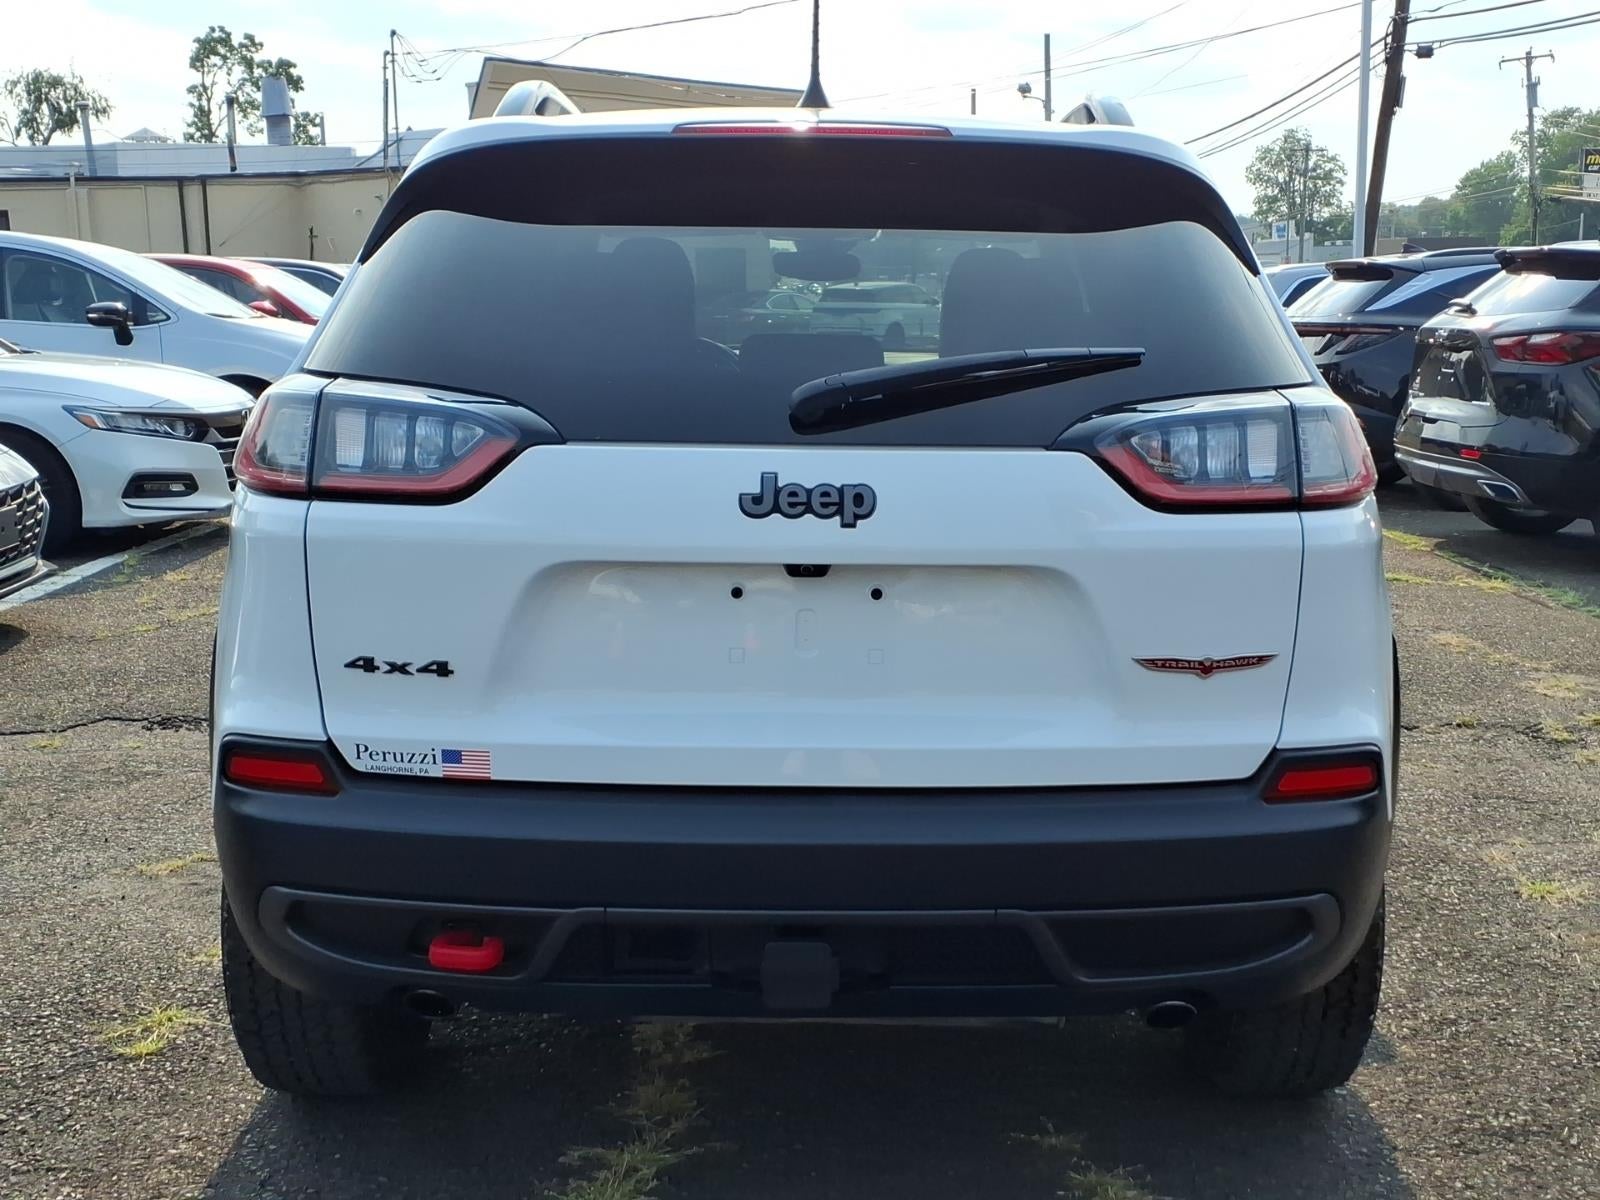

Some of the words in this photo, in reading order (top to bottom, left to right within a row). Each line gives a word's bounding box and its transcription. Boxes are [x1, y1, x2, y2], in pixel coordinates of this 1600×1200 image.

[738, 472, 877, 528] Jeep
[343, 655, 454, 677] 4x4
[354, 742, 439, 766] Peruzzi
[364, 763, 417, 775] LANGHORNE,
[419, 767, 430, 775] PA
